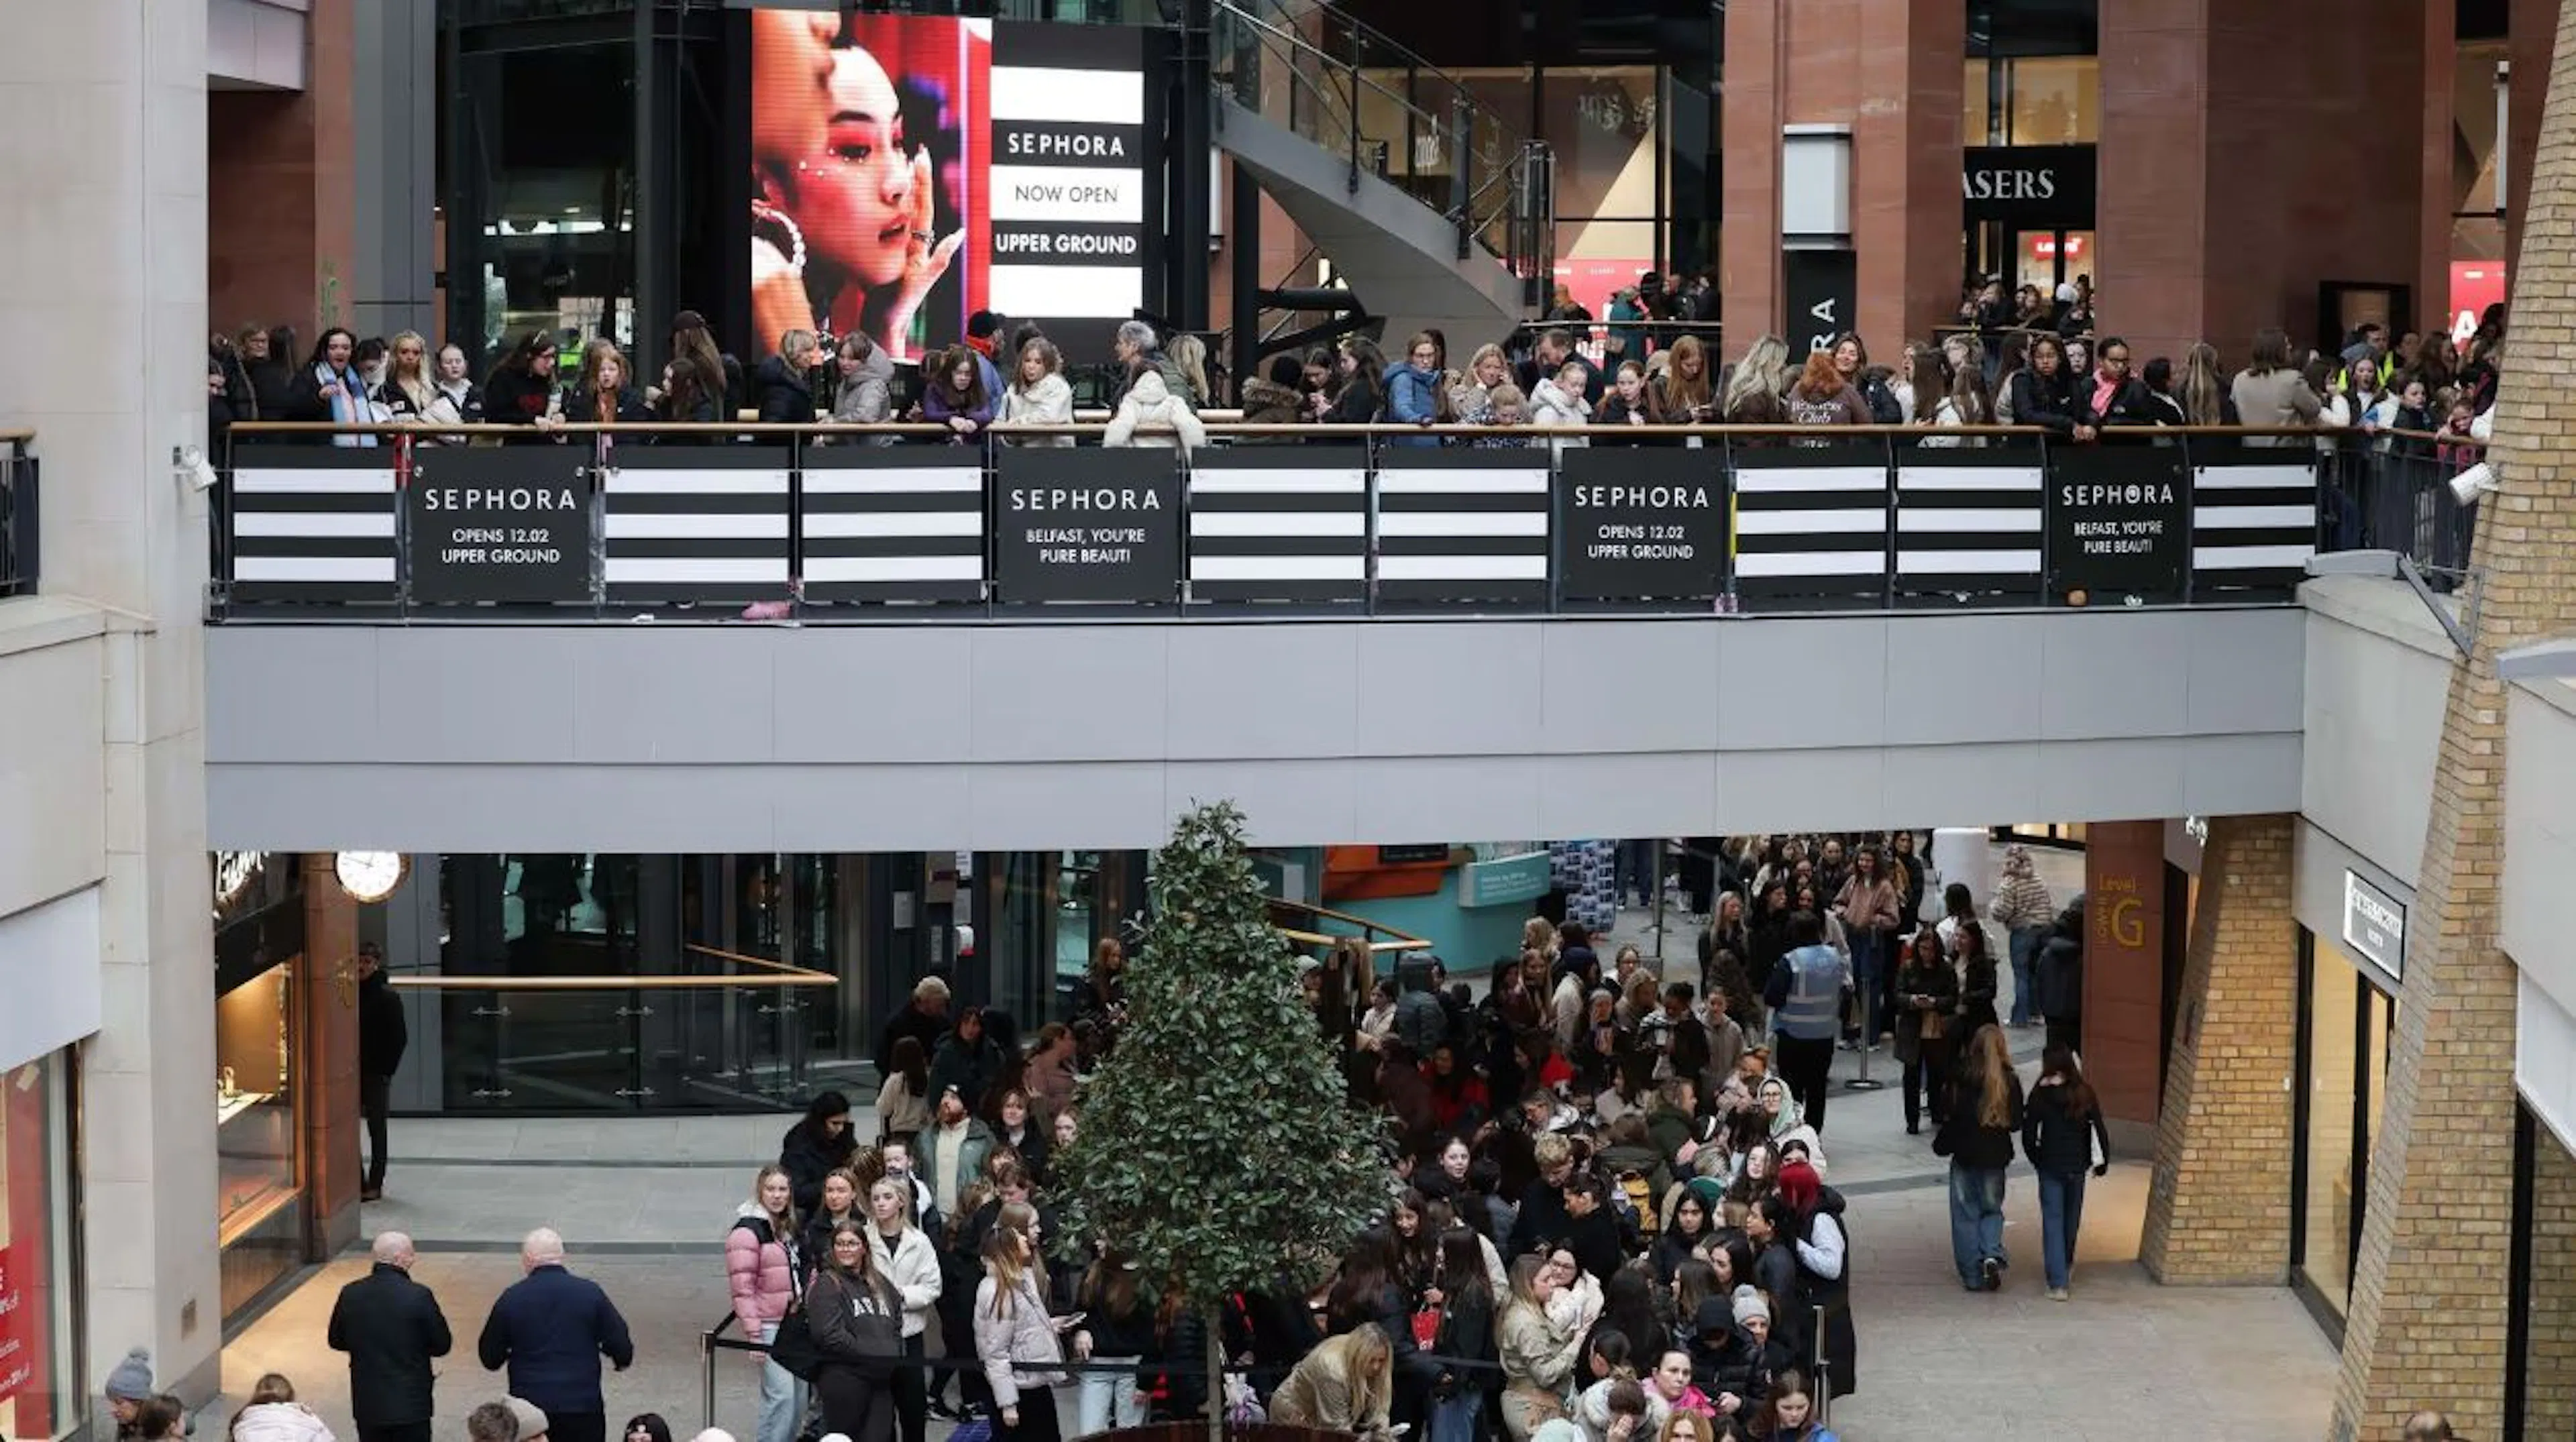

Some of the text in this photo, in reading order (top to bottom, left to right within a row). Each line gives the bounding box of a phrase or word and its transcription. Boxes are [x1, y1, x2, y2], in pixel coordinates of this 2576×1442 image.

[1008, 132, 1124, 156] SEPHORA
[1015, 185, 1118, 203] NOW OPEN
[996, 233, 1136, 255] UPPER GROUND
[425, 488, 576, 510] SEPHORA
[1010, 489, 1160, 510] SEPHORA
[1575, 485, 1709, 508] SEPHORA
[2062, 484, 2174, 506] SEPHORA
[452, 529, 549, 543] OPENS 12.02
[1026, 528, 1145, 545] BELFAST, YOU'RE
[1598, 524, 1684, 539] OPENS 12.02
[2074, 520, 2163, 537] BELFAST, YOU'RE
[1588, 544, 1693, 559] UPPER GROUND
[2084, 540, 2112, 553] PURE
[441, 549, 561, 564] UPPER GROUND
[1040, 549, 1077, 563] PURE
[2112, 898, 2145, 947] G
